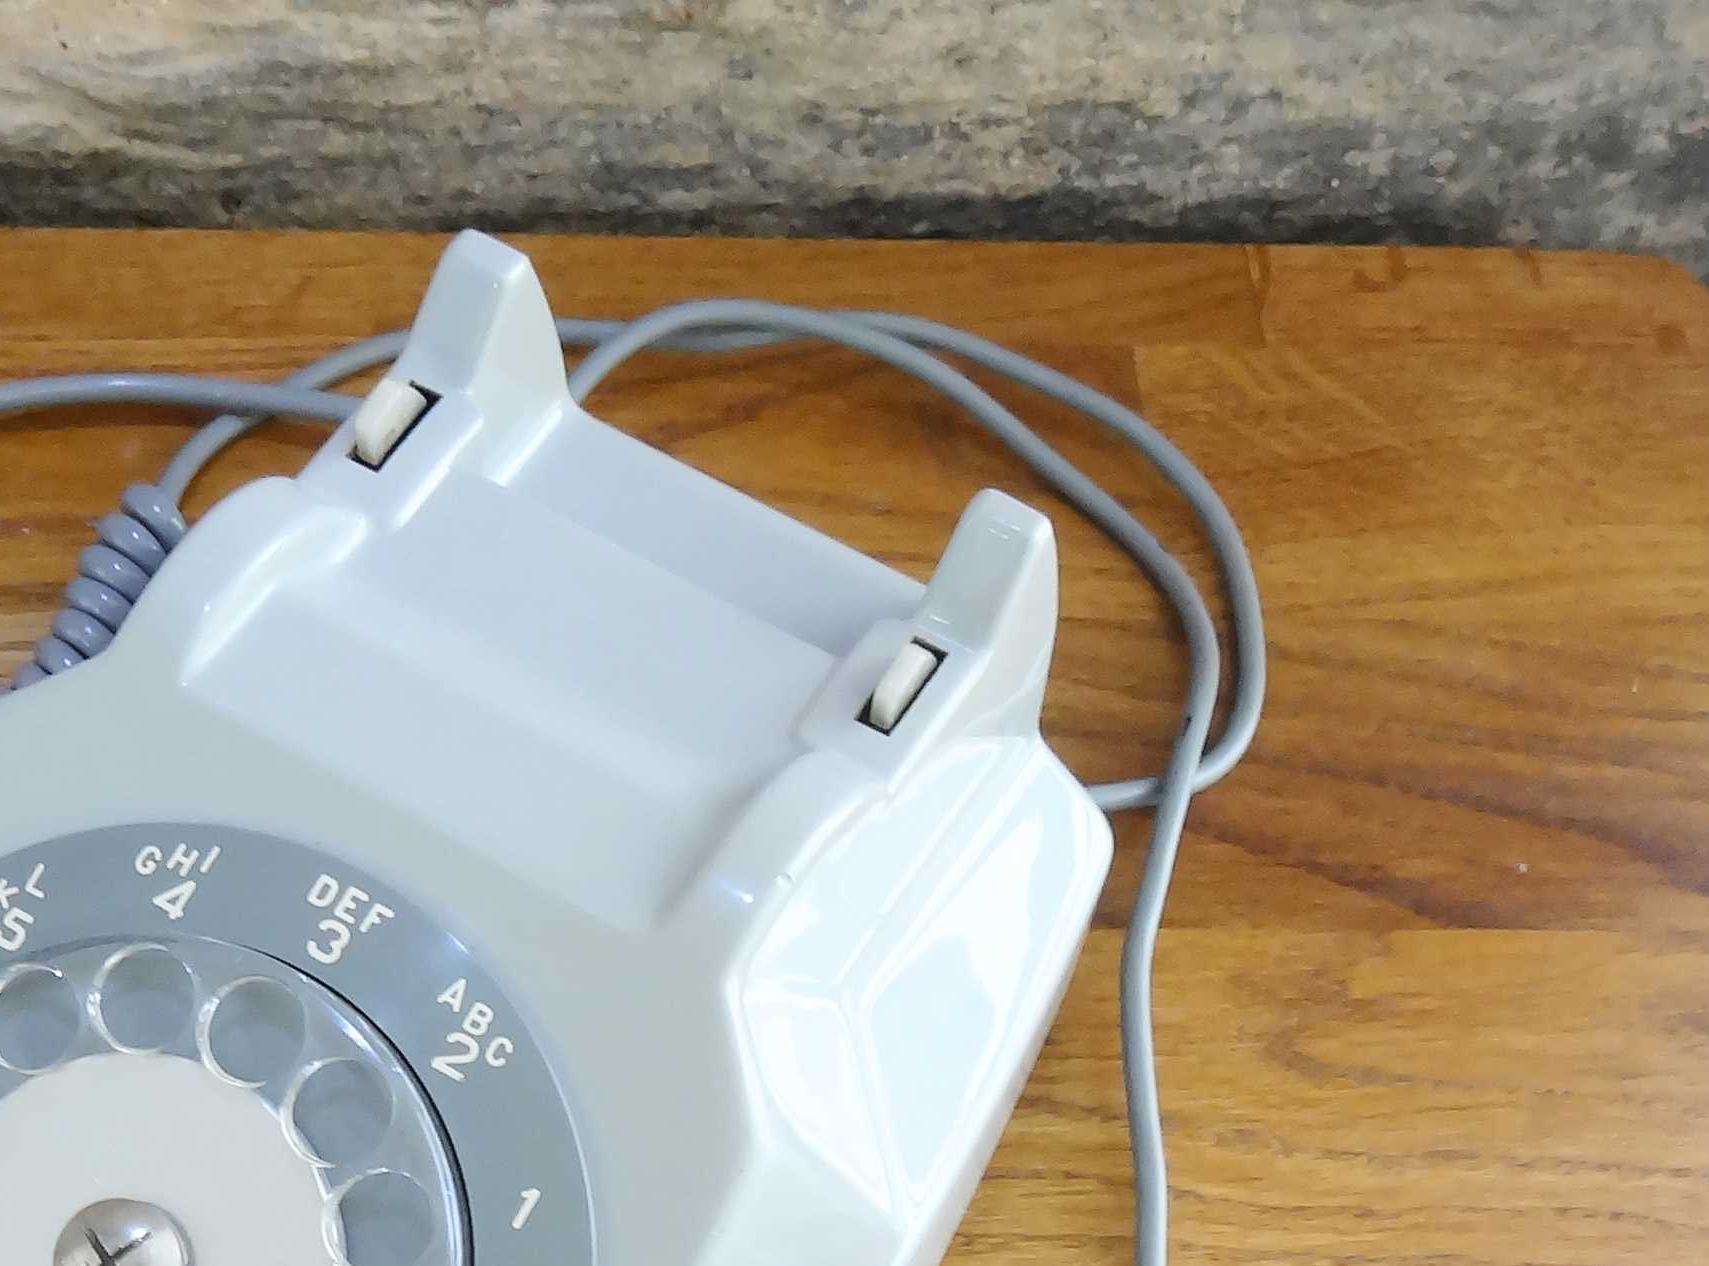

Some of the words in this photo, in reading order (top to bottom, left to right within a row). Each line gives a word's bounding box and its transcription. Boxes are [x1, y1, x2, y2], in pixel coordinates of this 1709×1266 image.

[135, 842, 221, 877] GHI
[152, 880, 197, 920] 4
[306, 873, 395, 933] DEF
[306, 919, 351, 965] 3
[436, 977, 514, 1069] ABC
[431, 1034, 479, 1082] 2
[510, 1187, 541, 1229] 1
